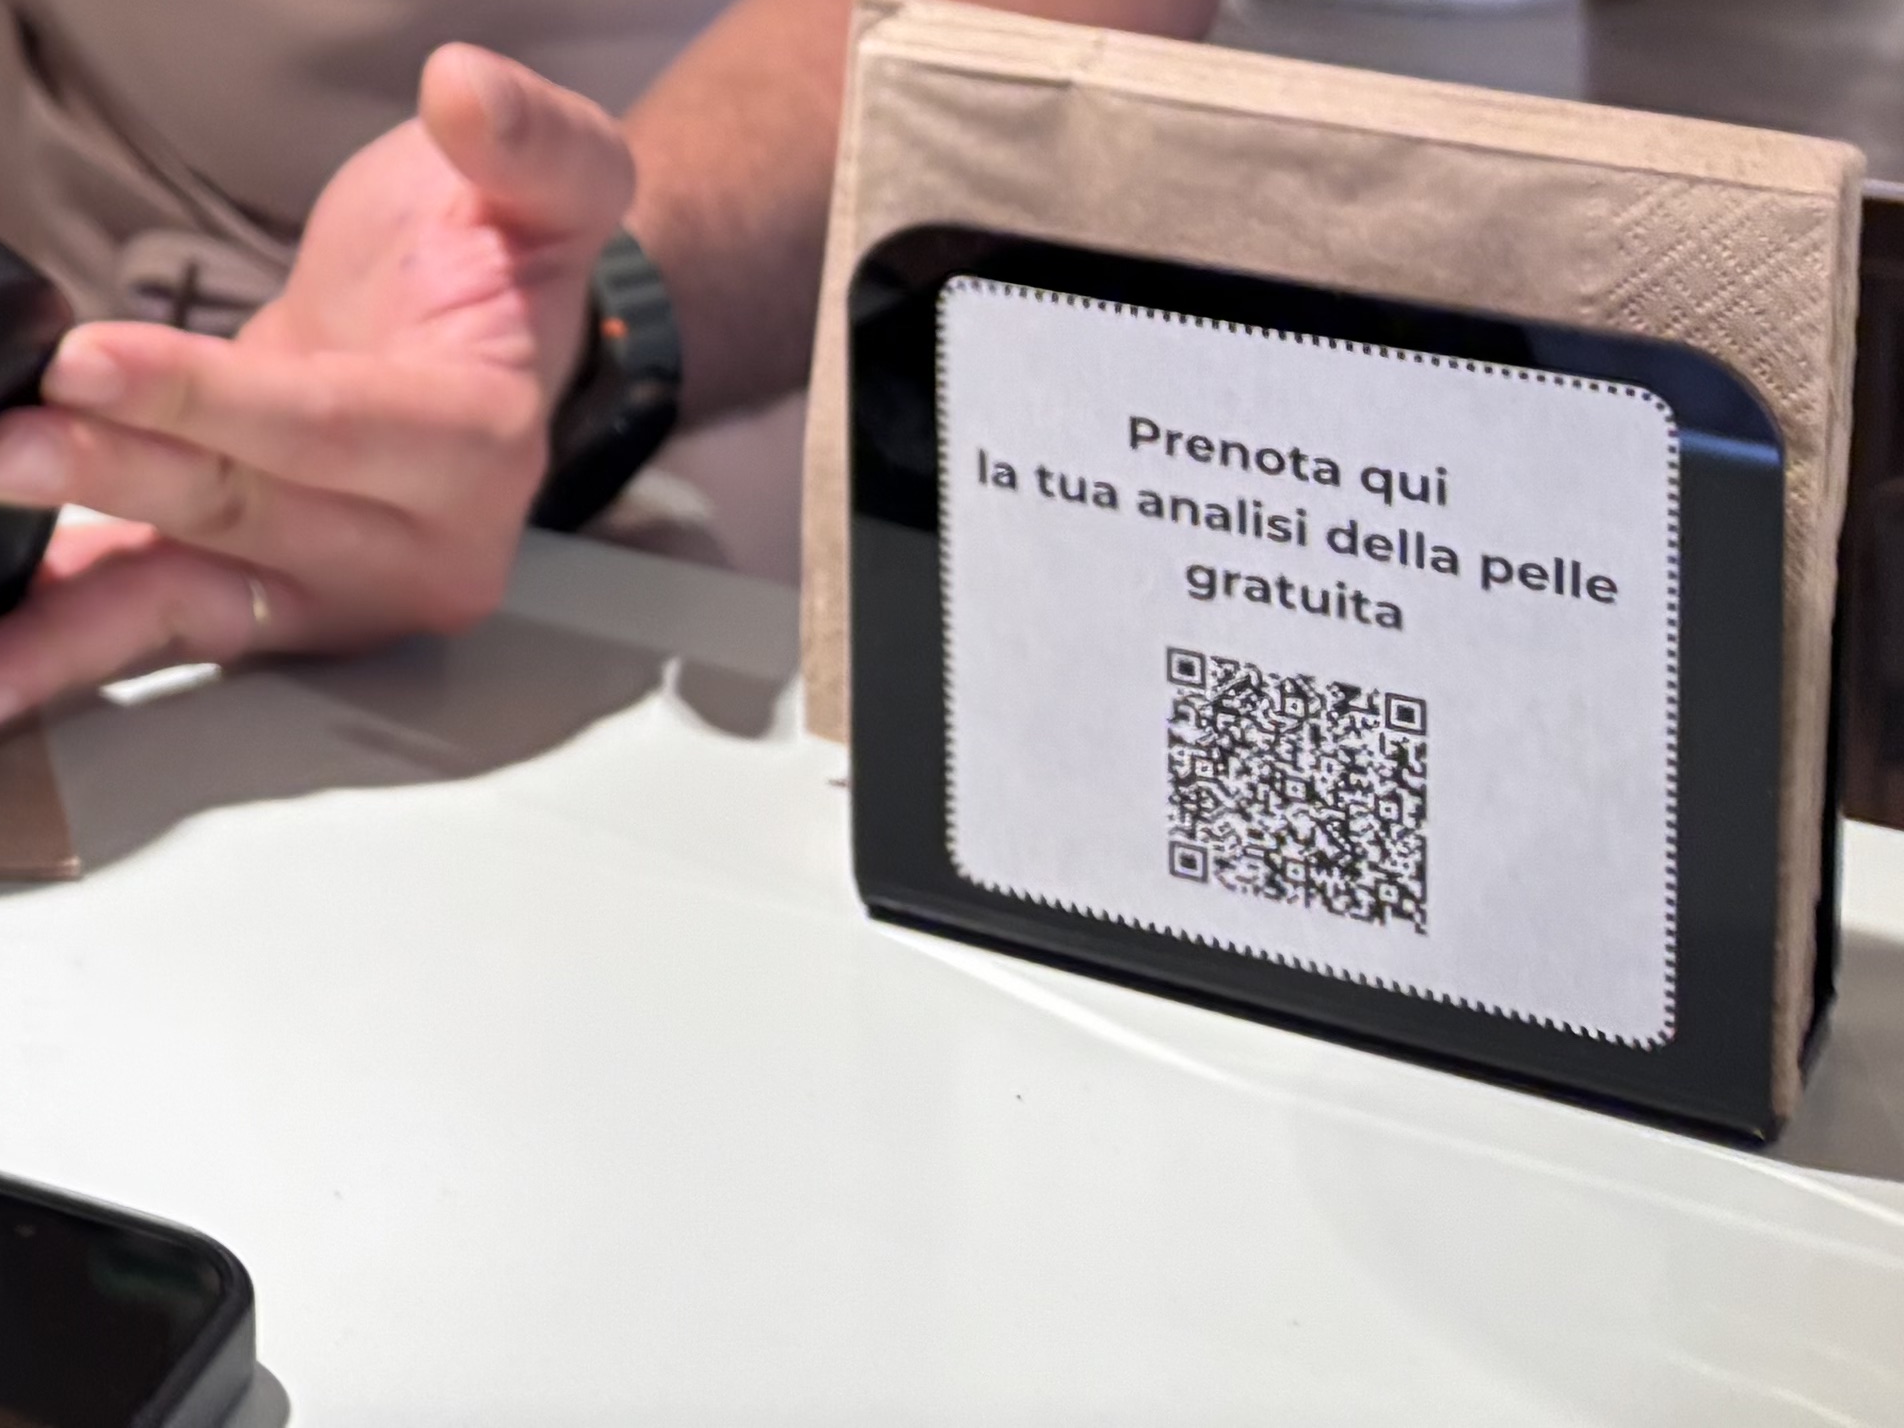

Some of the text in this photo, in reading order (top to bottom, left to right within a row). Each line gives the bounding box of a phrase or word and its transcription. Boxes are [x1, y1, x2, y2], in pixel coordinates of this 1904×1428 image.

[1128, 415, 1449, 508] Prenota qui
[977, 448, 1620, 606] la tua analisi della pelle
[1185, 563, 1404, 632] gratuita
